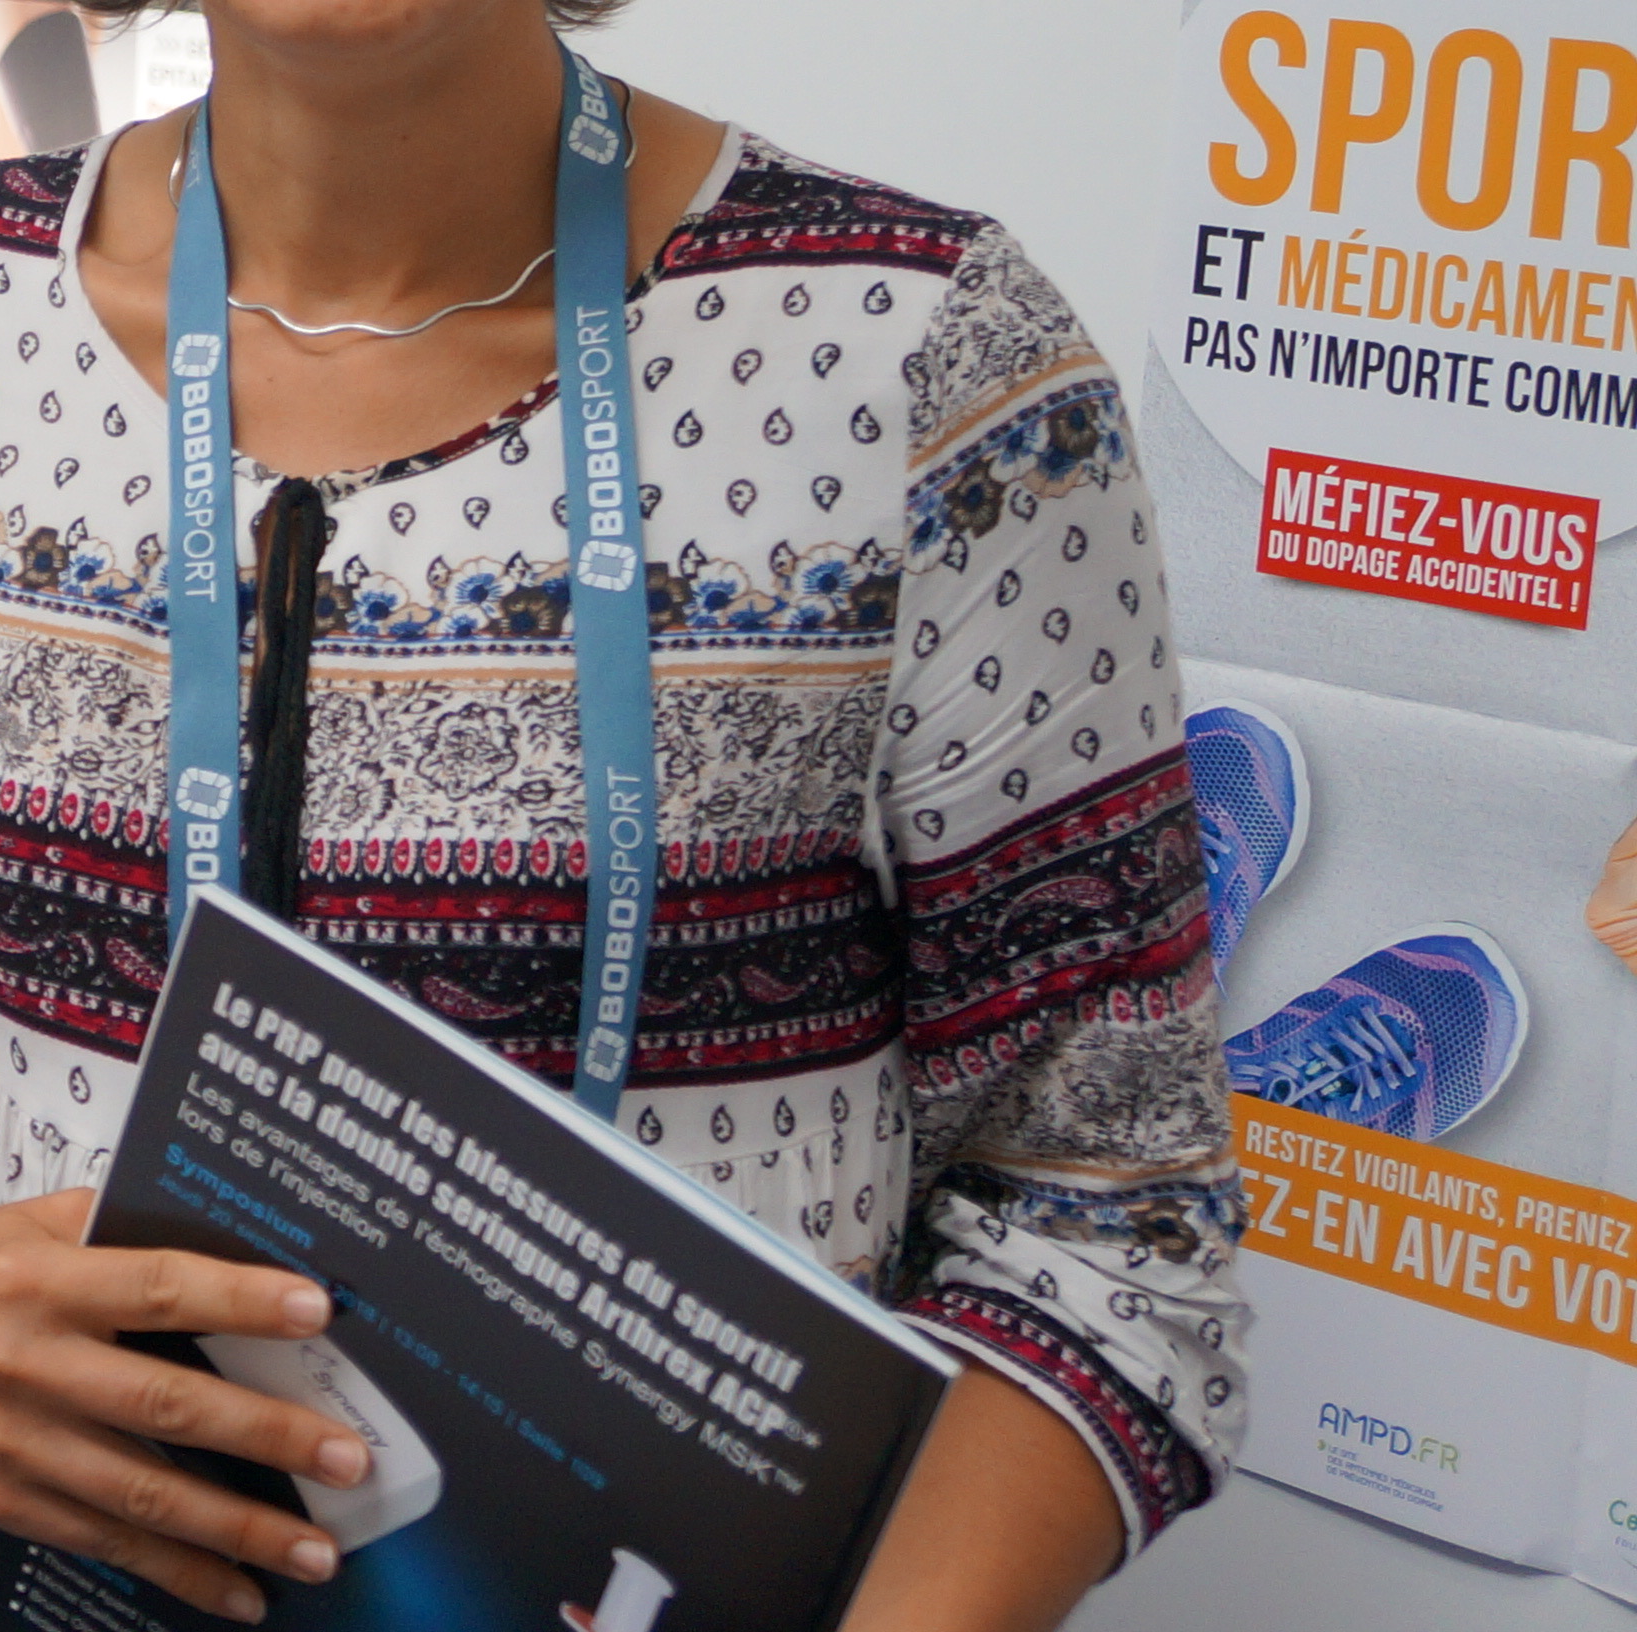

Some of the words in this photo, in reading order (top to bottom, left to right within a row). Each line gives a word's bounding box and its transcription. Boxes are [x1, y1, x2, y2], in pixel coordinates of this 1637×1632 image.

[1192, 224, 1264, 300] ET
[1183, 316, 1259, 374] PAS
[575, 304, 627, 538] BOBOSPORT
[182, 378, 219, 603] BOBOSPORT
[1272, 465, 1588, 571] MÉFIEZ-VOUS
[1268, 529, 1298, 564] DU
[1305, 536, 1400, 583] DOPAGE
[1405, 551, 1562, 611] ACCIDENTEL
[1568, 582, 1580, 613] !
[594, 764, 645, 1026] BOBOSPORT
[176, 1098, 226, 1145] lors
[229, 1133, 266, 1169] de
[165, 1142, 315, 1250] Symposium
[198, 1032, 279, 1098] avec
[279, 1074, 318, 1122] la
[316, 1103, 432, 1197] double
[431, 1179, 582, 1302] seringue
[577, 1281, 715, 1395] Arthrex
[212, 981, 255, 1029] Le
[254, 1006, 323, 1066] PRP
[319, 1052, 403, 1120] pour
[400, 1099, 456, 1158] les
[455, 1135, 624, 1276] blessures
[622, 1258, 676, 1310] du
[672, 1292, 805, 1394] sportif
[1245, 1120, 1347, 1179] RESTEZ
[1353, 1150, 1506, 1228] VIGILANTS,
[1515, 1196, 1632, 1259] PRENEZ
[186, 1071, 235, 1117] Les
[238, 1109, 371, 1204] avantages
[375, 1196, 410, 1230] de
[581, 1338, 699, 1434] Synergy
[1392, 1215, 1533, 1309] AVEC
[312, 1369, 390, 1449] Synergy
[1318, 1402, 1460, 1475] AMPD.FR
